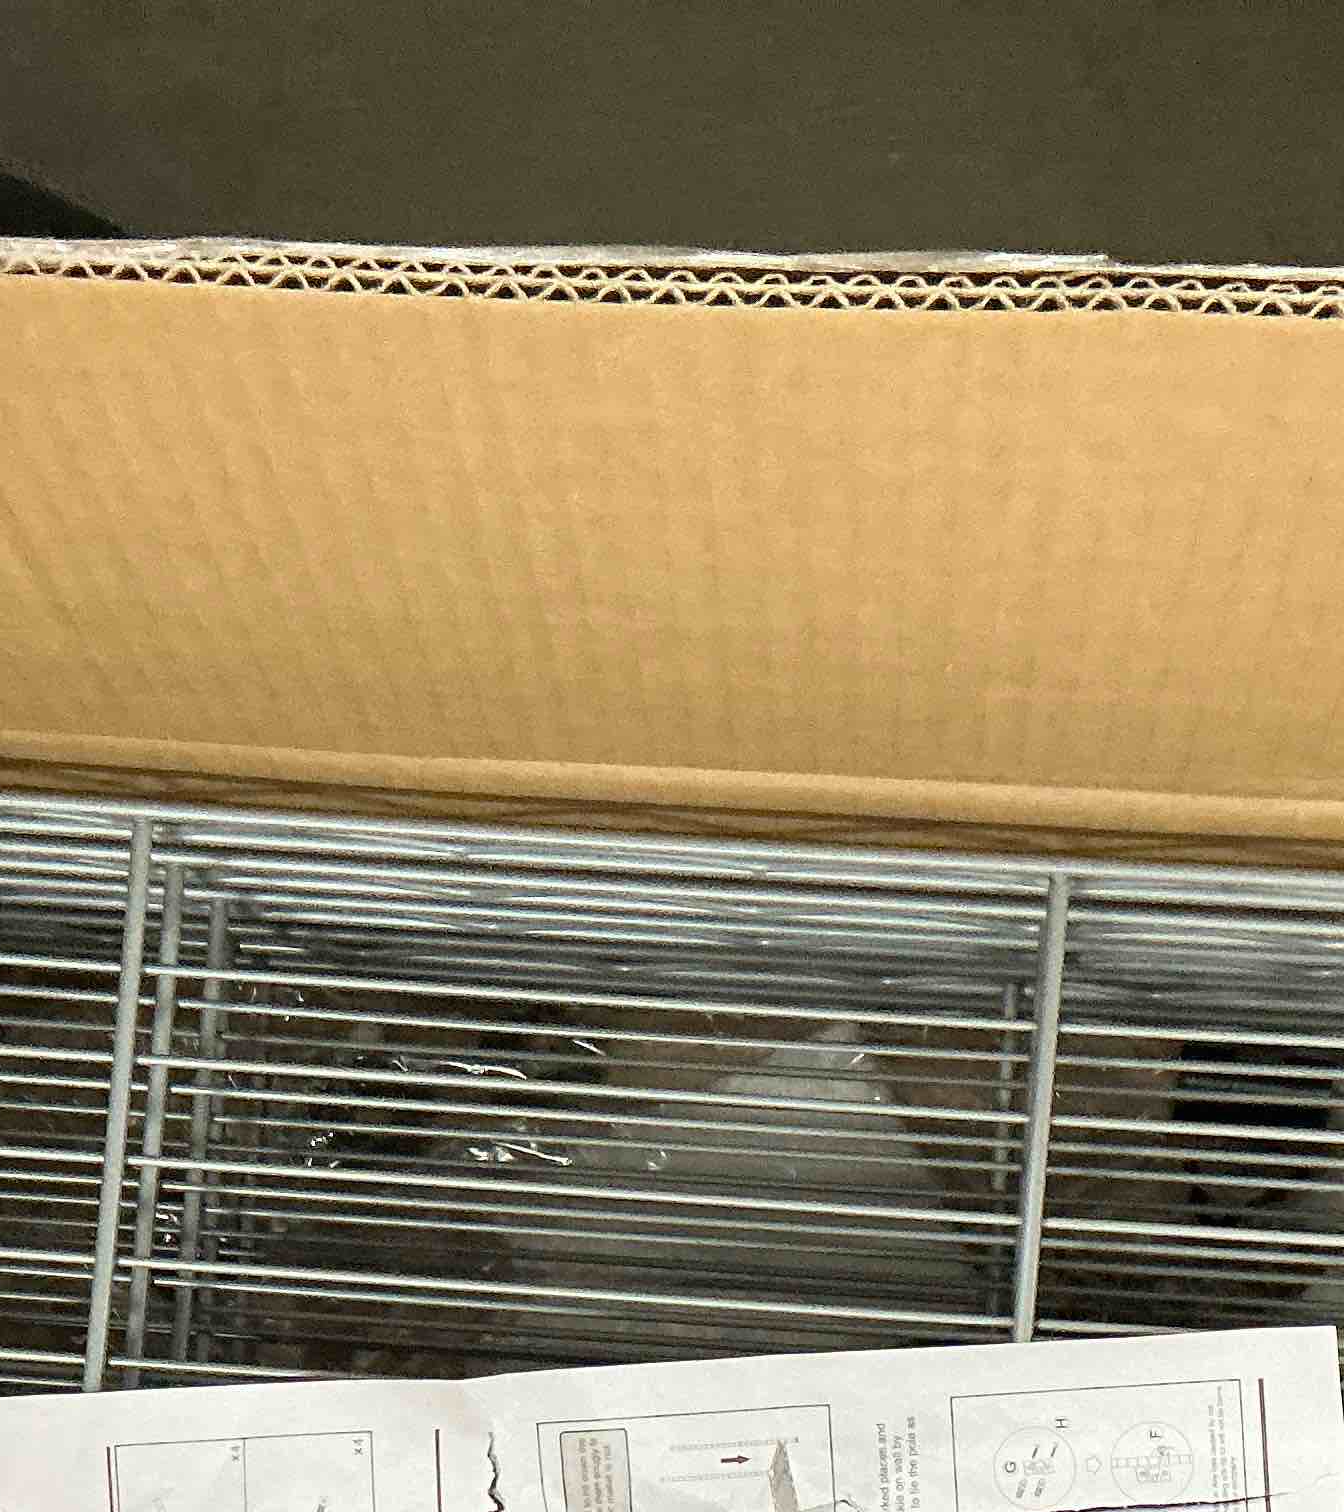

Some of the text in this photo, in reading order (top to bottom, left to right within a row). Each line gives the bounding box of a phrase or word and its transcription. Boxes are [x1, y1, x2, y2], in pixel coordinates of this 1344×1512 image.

[1054, 1417, 1068, 1428] H
[1149, 1429, 1162, 1439] F
[1003, 1460, 1017, 1473] G
